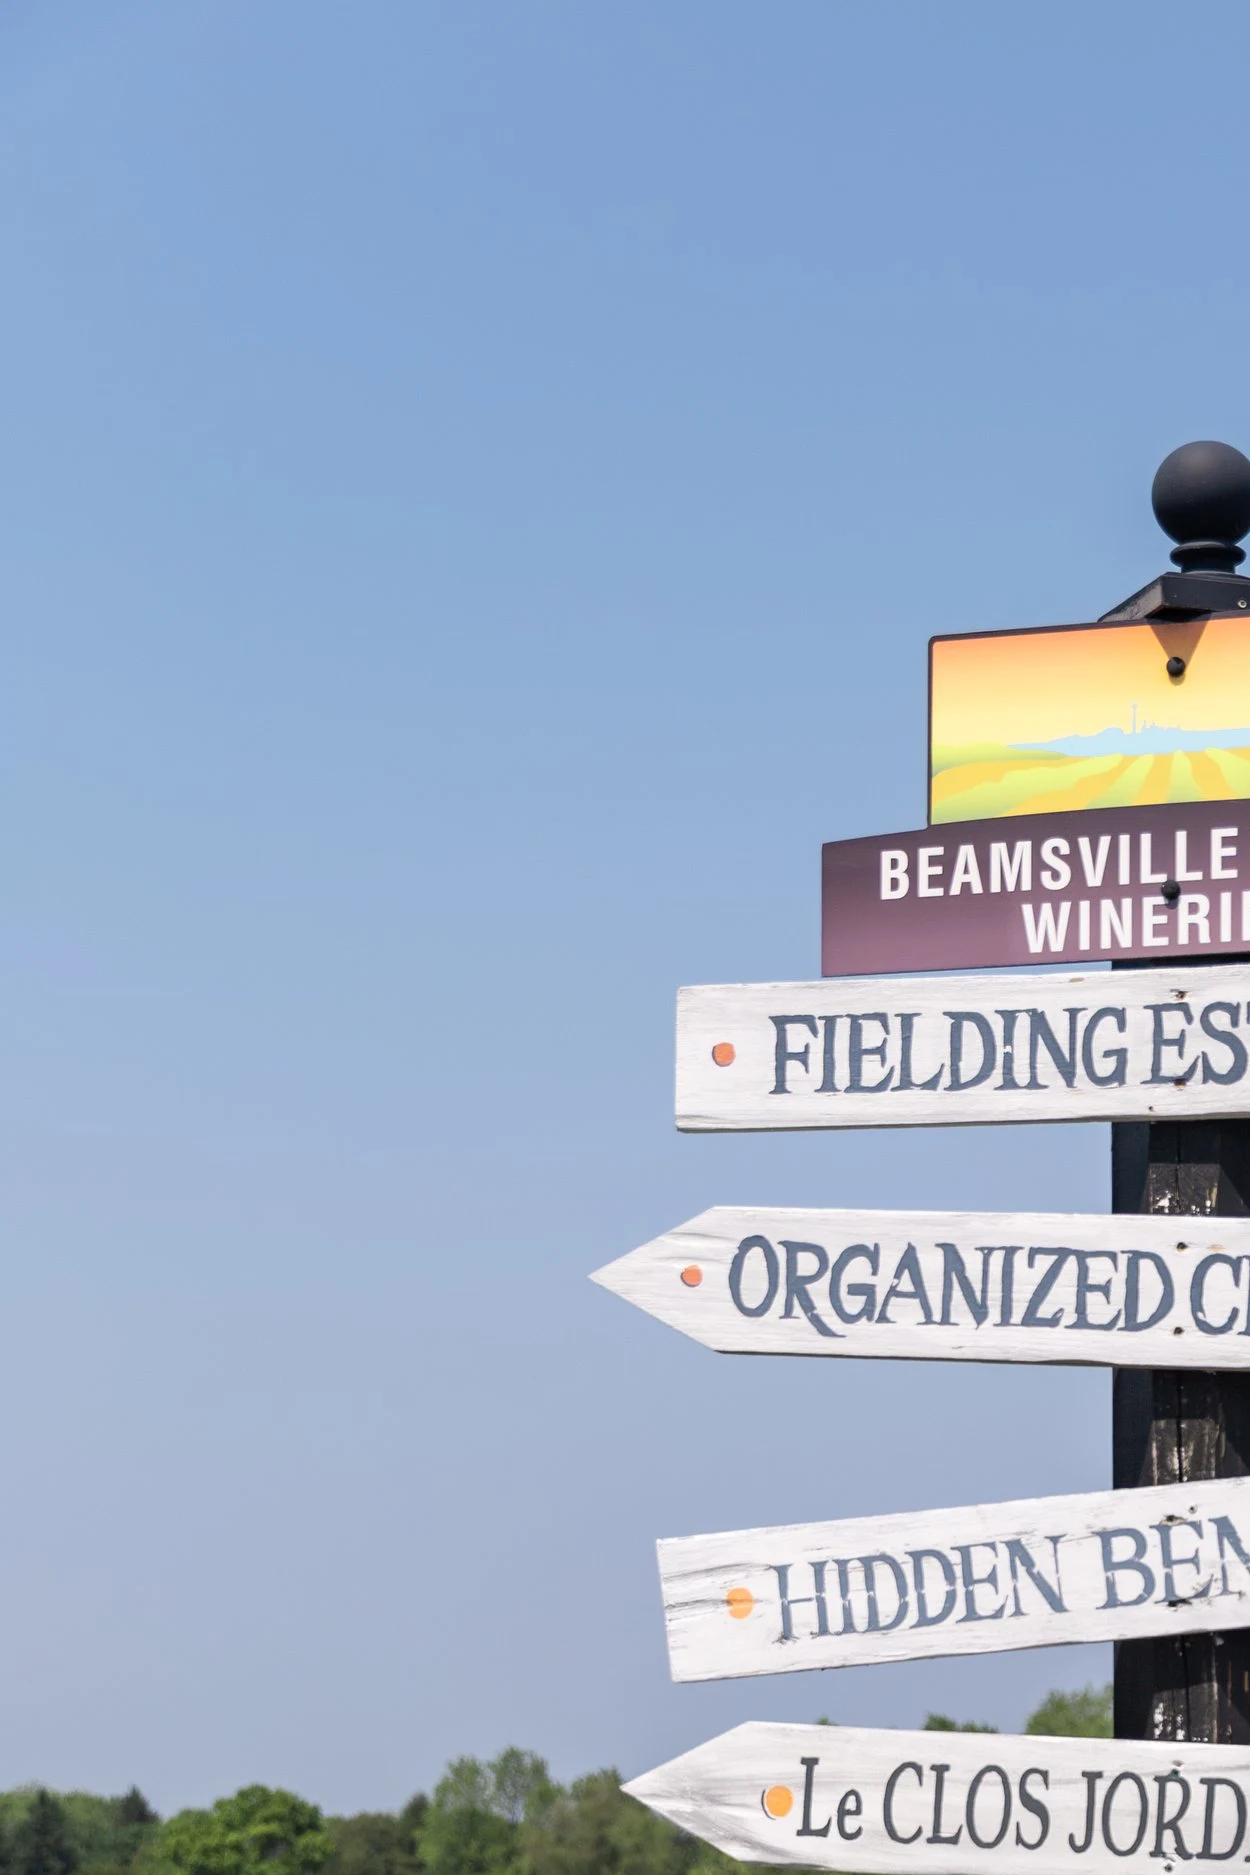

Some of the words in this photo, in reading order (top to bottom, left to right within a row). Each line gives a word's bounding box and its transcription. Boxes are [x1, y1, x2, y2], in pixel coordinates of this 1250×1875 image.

[880, 826, 1239, 901] BEAMSVILLE
[768, 1007, 1129, 1095] FIELDING
[728, 1234, 1176, 1338] ORGANIZED
[771, 1534, 1070, 1643] HIDDEN
[797, 1757, 863, 1840] Le
[882, 1761, 1051, 1850] CLOS
